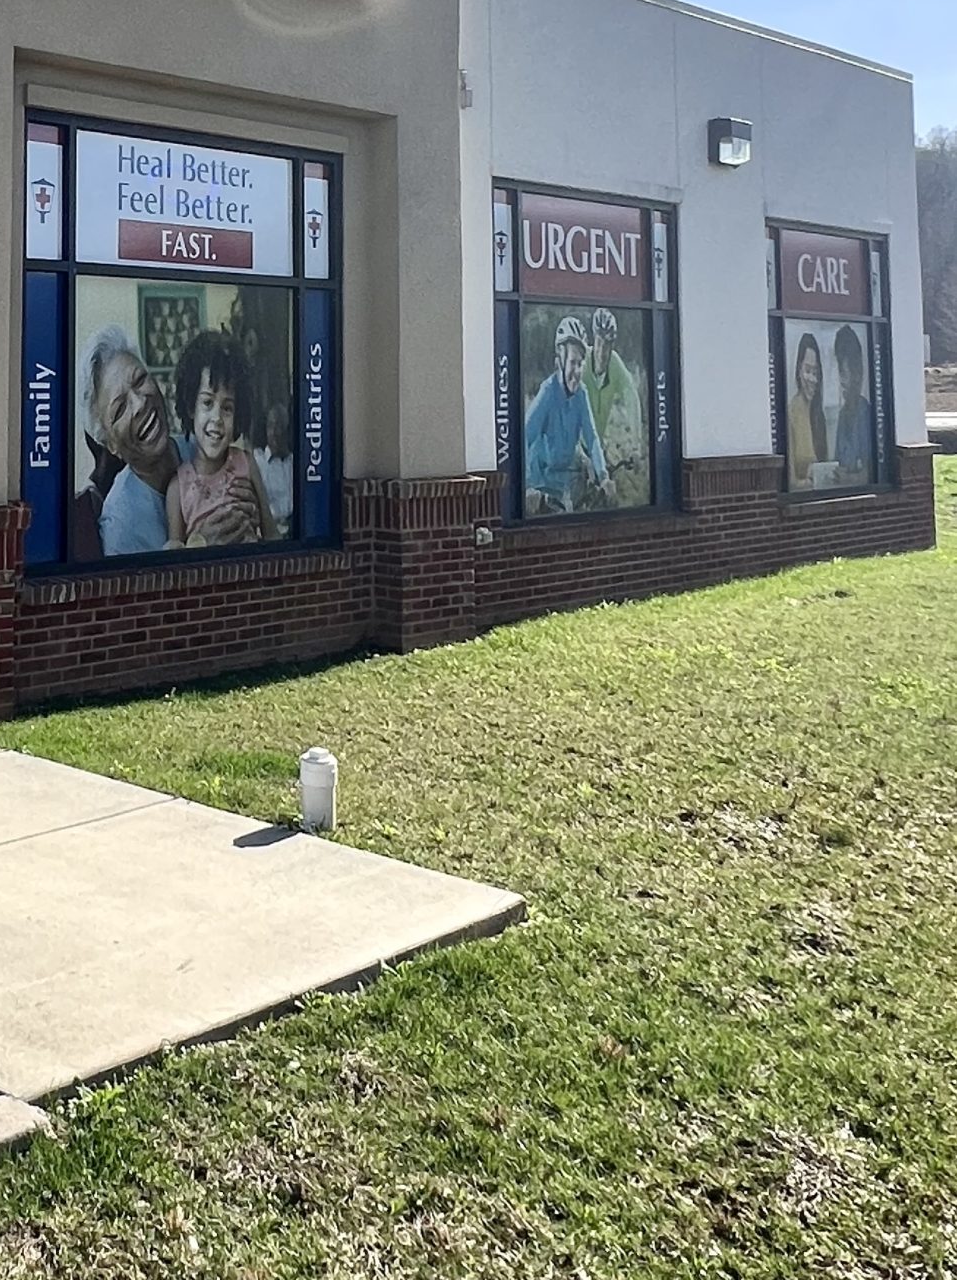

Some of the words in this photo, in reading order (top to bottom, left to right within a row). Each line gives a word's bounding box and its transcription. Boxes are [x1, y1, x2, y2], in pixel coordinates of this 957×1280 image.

[118, 144, 171, 179] Heal
[182, 153, 253, 189] Better.
[118, 182, 165, 215] Feel
[176, 189, 253, 224] Better.
[161, 229, 217, 261] FAST.
[522, 219, 641, 277] URGENT
[798, 253, 850, 296] CARE
[29, 363, 56, 468] Family
[306, 343, 322, 481] Pediatrics
[497, 354, 510, 465] Wellness
